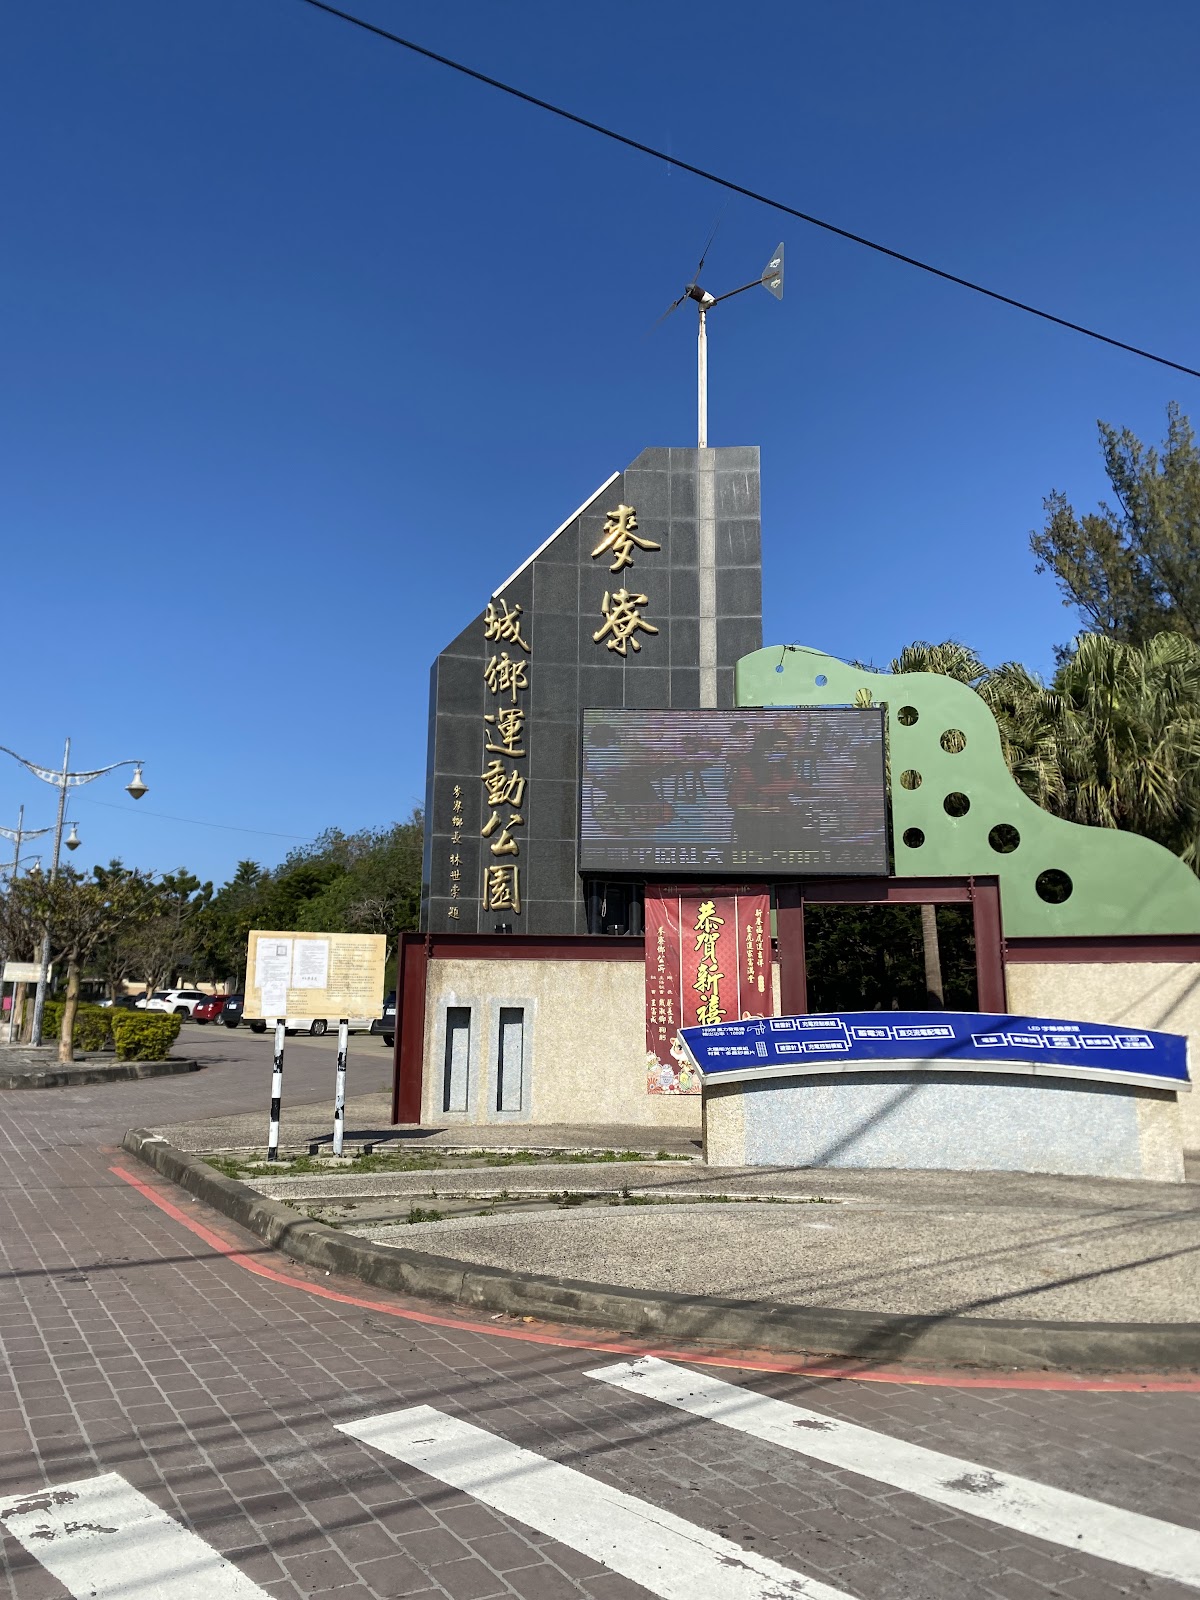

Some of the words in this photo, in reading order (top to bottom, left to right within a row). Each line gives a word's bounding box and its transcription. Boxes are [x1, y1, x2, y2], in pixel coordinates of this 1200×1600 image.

[590, 503, 662, 658] 麥寮
[481, 598, 532, 914] 城鄉運動公園
[657, 926, 665, 973] 麥寮鄉公所
[692, 900, 727, 1026] 恭賀新禧
